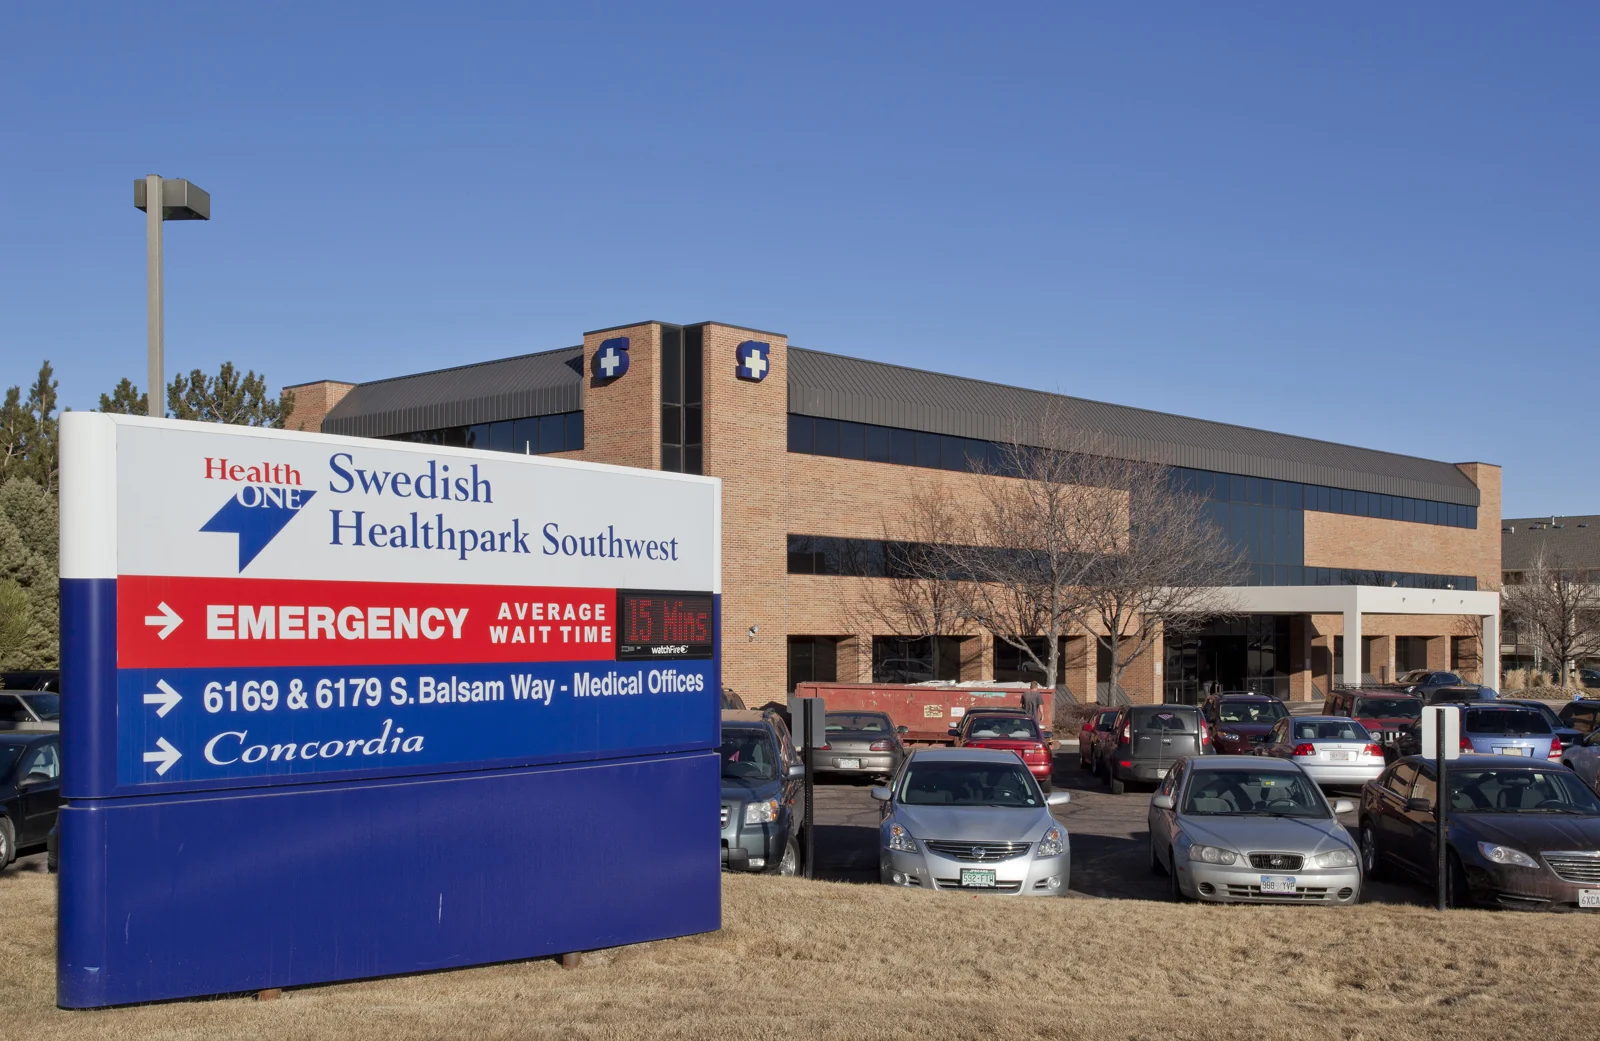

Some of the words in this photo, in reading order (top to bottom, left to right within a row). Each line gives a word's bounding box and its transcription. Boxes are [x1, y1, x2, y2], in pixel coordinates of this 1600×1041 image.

[204, 457, 302, 486] Health
[329, 452, 493, 504] Swedish
[236, 485, 303, 509] ONE
[330, 509, 531, 561] Healthpark
[541, 522, 679, 562] Southwest
[206, 604, 469, 640] EMERGENCY
[497, 602, 606, 621] AVERAGE
[629, 599, 652, 641] 15
[663, 600, 707, 641] Mins
[489, 625, 549, 644] WAIT
[559, 625, 612, 643] TIME
[203, 680, 279, 713] 6169
[286, 678, 309, 710] &
[315, 677, 382, 709] 6179
[390, 676, 414, 706] S.
[419, 675, 504, 704] Balsam
[510, 673, 555, 706] Way
[574, 670, 643, 697] Medical
[648, 669, 704, 694] Offices
[204, 719, 424, 766] Concordia
